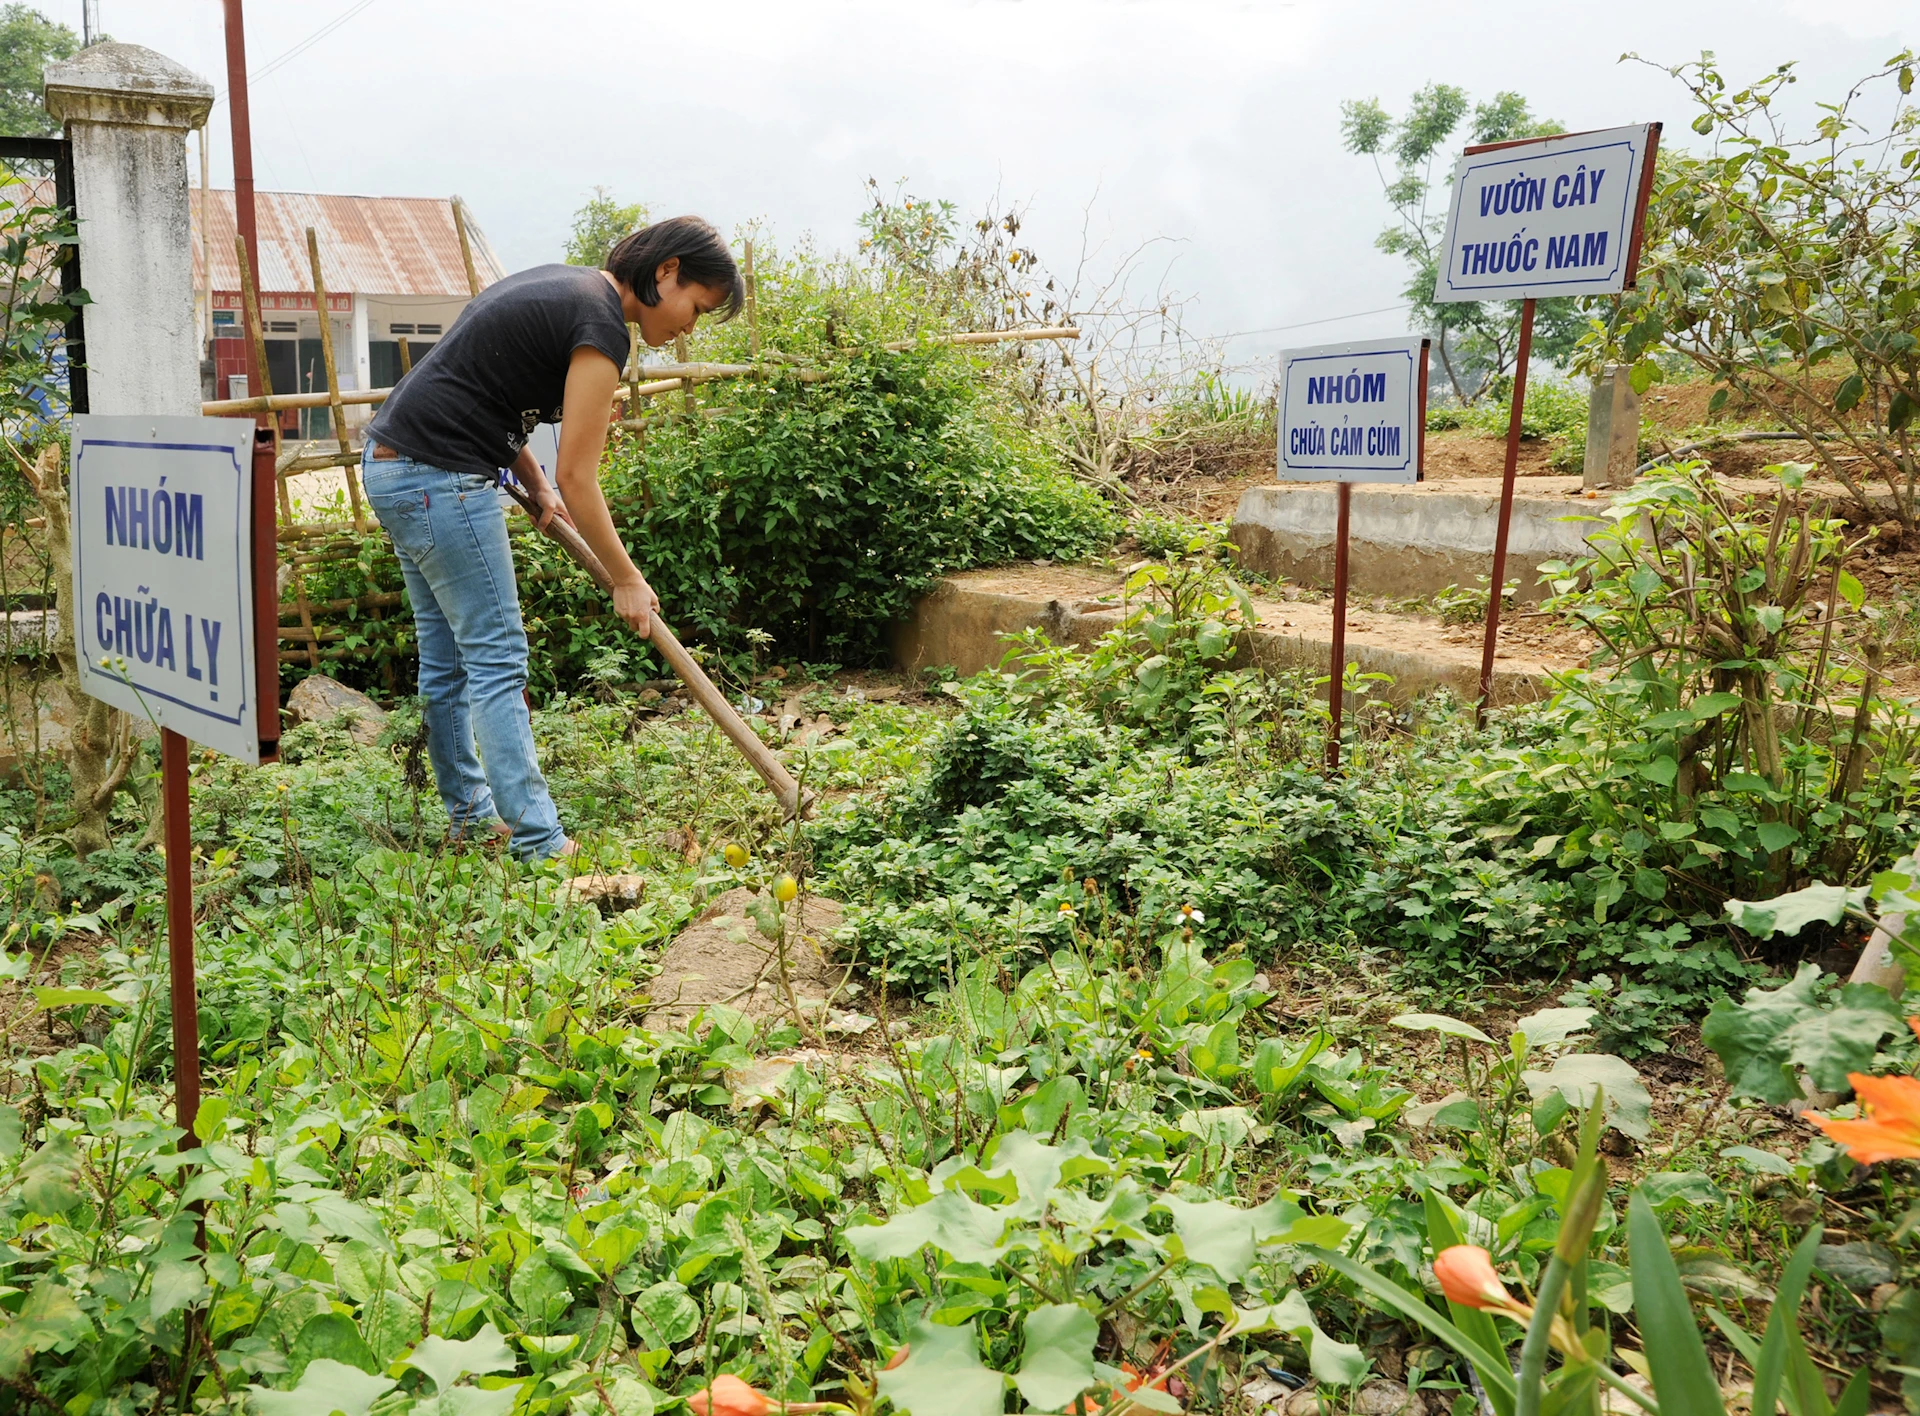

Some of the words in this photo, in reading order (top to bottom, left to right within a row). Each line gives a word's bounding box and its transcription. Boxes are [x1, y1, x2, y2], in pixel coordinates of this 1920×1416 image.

[1479, 171, 1547, 217] VƯỜN
[1552, 164, 1606, 209] CÂY
[1461, 227, 1539, 276] THUỐC
[1545, 230, 1609, 270] NAM
[1307, 367, 1386, 405] NHÓM
[1290, 420, 1326, 456] CHỮA
[1330, 414, 1364, 456] CẢM
[1367, 420, 1400, 456] CÚM
[104, 476, 204, 561] NHÓM
[95, 585, 176, 673] CHỮA
[184, 613, 221, 702] LỴ
